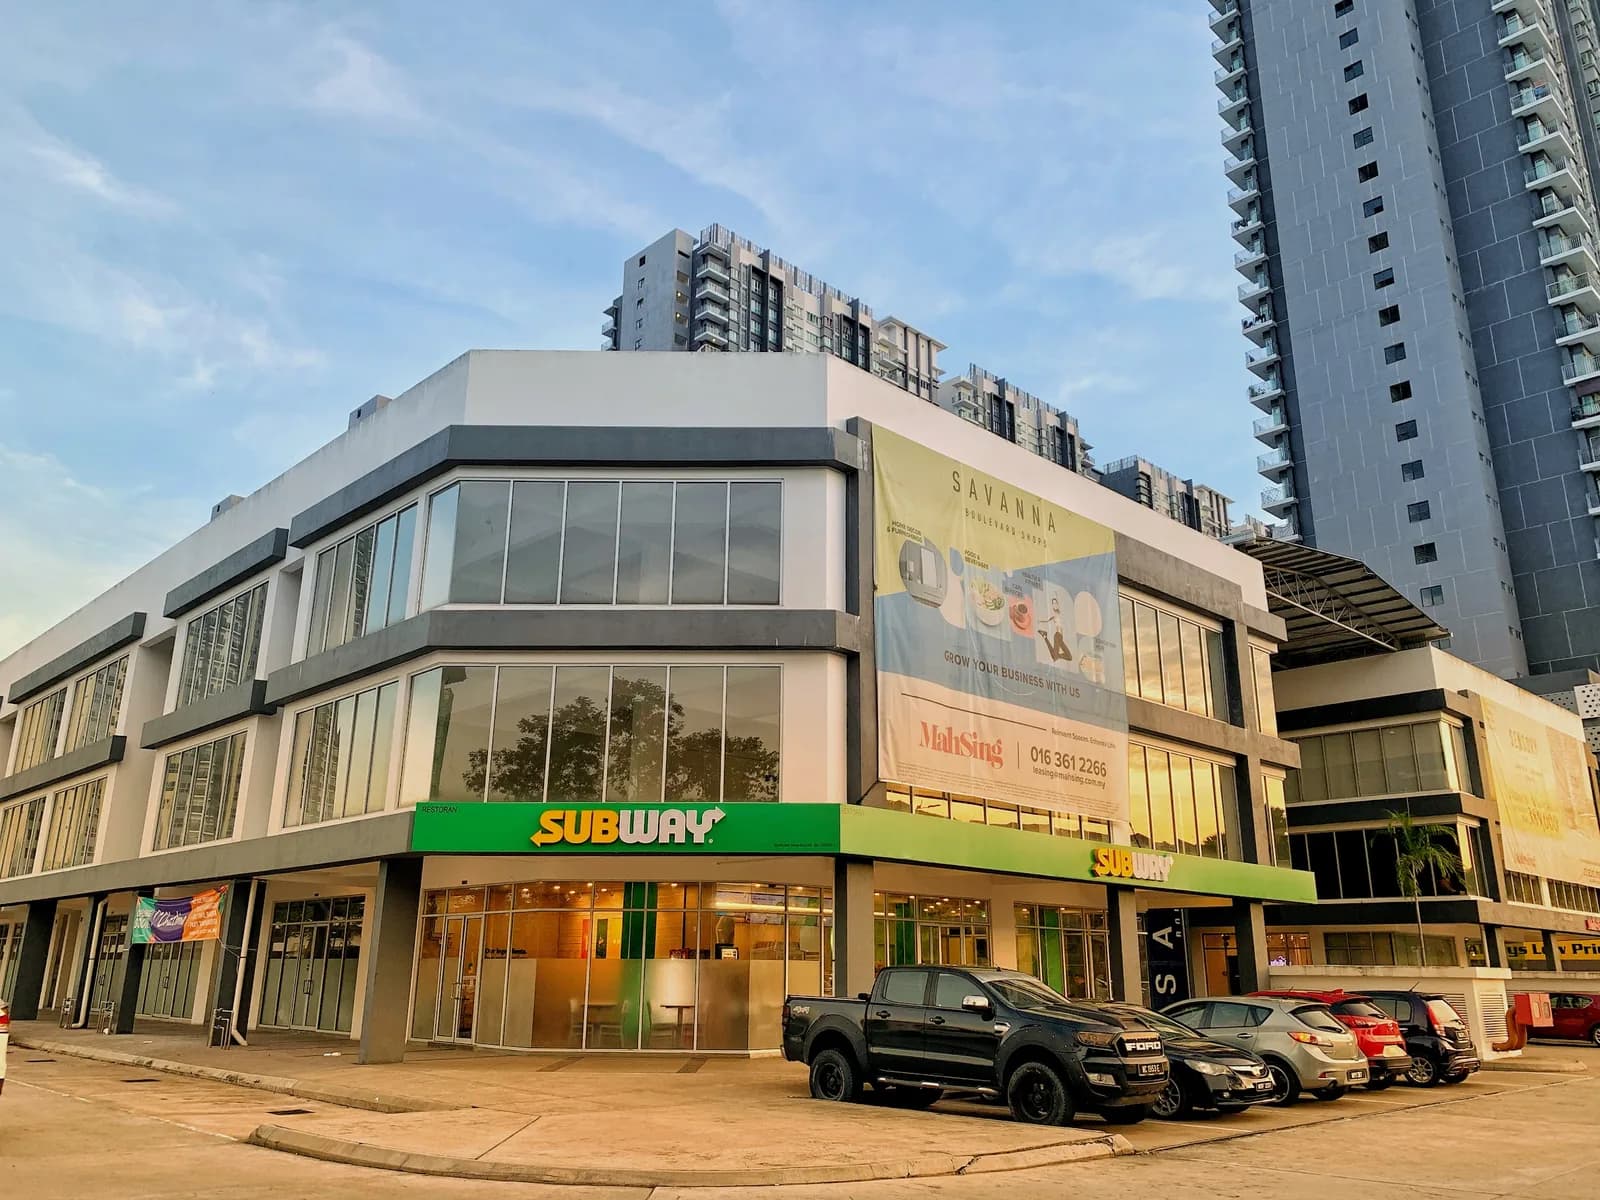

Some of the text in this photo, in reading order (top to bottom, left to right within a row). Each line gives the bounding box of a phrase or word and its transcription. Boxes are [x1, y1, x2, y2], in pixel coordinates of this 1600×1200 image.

[952, 470, 1057, 533] SAVANNA
[964, 507, 1047, 548] BOULEVARD SHOPS
[944, 650, 1081, 698] GROW YOUR BUSINESS WITH US
[1030, 746, 1107, 777] 016 361 2266
[1032, 766, 1106, 790] leasing@mahsing.com.my
[422, 805, 457, 814] RESTORAN
[530, 806, 726, 847] SUBWAY
[1094, 847, 1174, 881] SUBWAY
[1125, 1041, 1161, 1051] FORD
